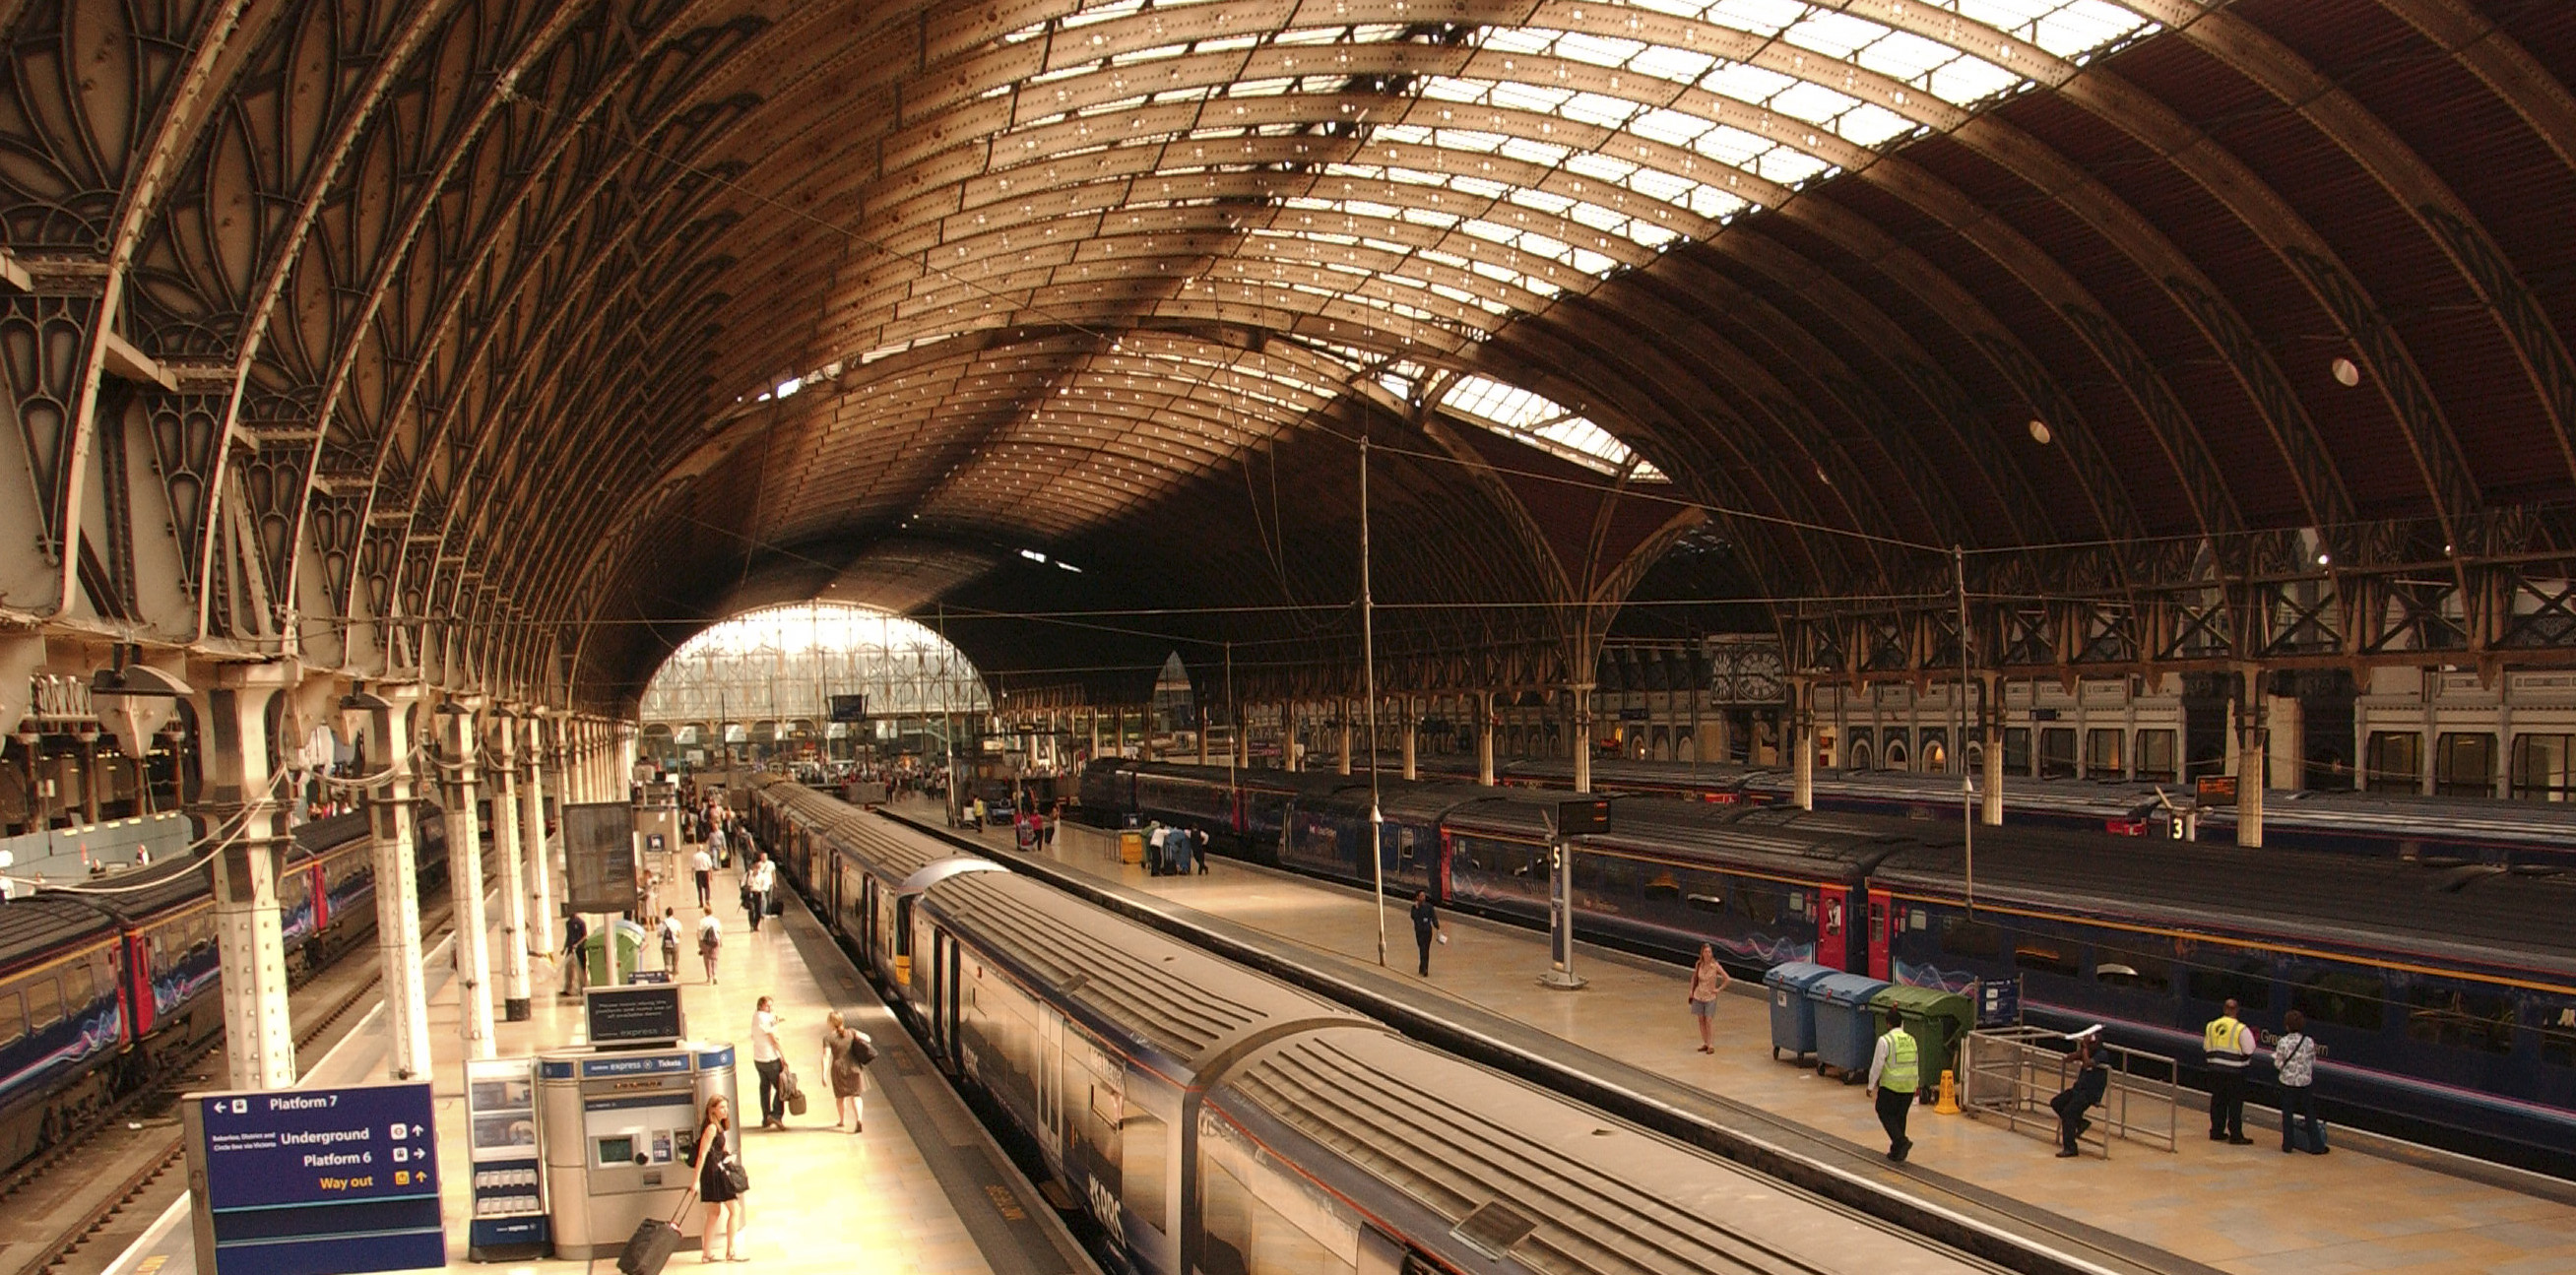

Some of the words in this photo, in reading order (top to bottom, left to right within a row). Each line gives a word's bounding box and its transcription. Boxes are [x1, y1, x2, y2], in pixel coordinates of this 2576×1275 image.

[2172, 817, 2183, 839] 3
[1553, 846, 1561, 869] 5
[611, 1061, 642, 1071] express
[657, 1059, 681, 1068] Tickets
[270, 1096, 326, 1111] Platform
[329, 1095, 338, 1107] 7
[281, 1127, 369, 1145] Underground
[304, 1152, 360, 1167] Platform
[362, 1151, 372, 1163] 6
[320, 1178, 348, 1190] Way
[351, 1176, 373, 1187] out
